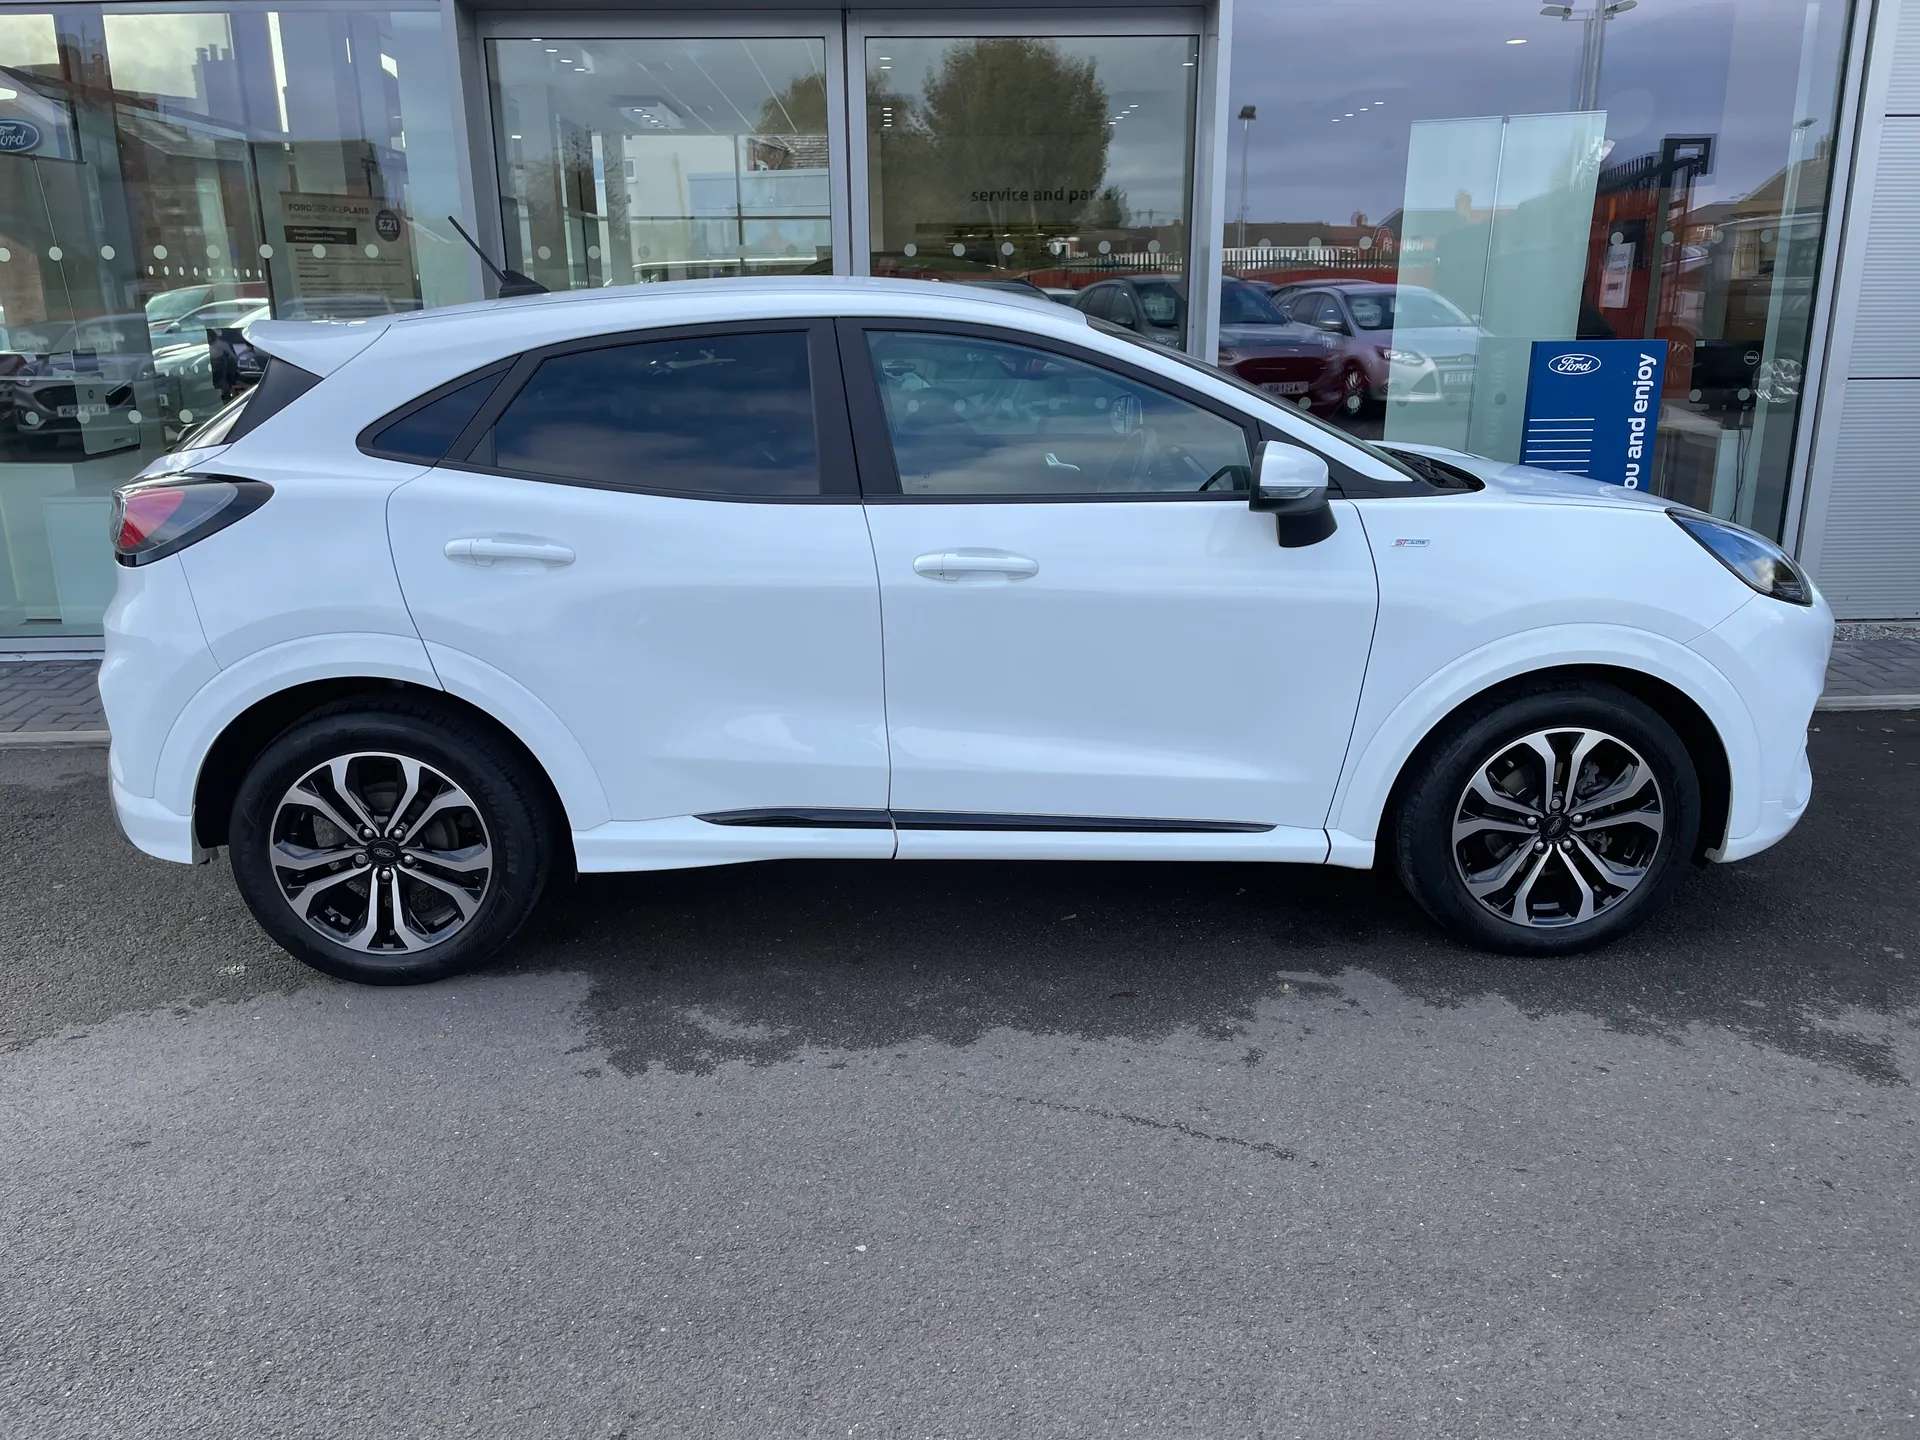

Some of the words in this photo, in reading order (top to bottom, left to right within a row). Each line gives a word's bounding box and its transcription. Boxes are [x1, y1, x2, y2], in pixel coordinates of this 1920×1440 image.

[971, 187, 1028, 202] service
[1033, 186, 1064, 201] and
[1068, 188, 1112, 204] pars
[1557, 356, 1592, 372] Ford
[1632, 353, 1657, 413] enjoy
[1626, 417, 1646, 459] and
